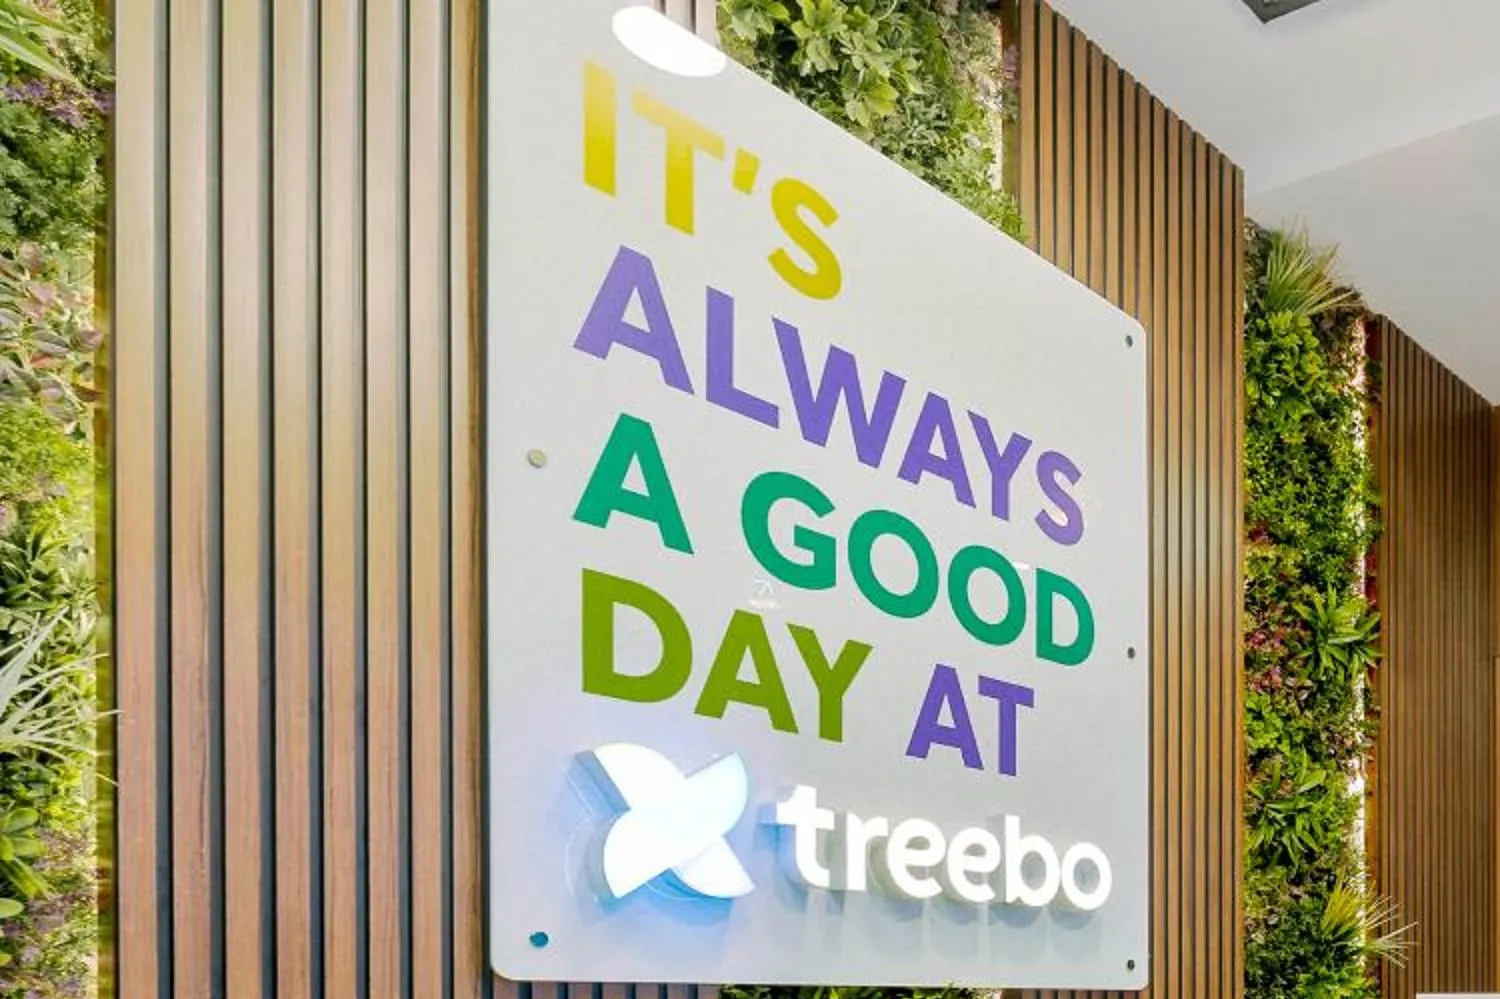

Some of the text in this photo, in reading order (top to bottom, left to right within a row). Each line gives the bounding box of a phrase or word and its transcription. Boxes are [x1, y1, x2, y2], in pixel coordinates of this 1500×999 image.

[581, 56, 842, 300] IT'S
[573, 245, 1085, 545] ALWAYS
[573, 413, 1095, 666] A GOOD
[581, 568, 1034, 777] DAY AT
[776, 785, 1112, 912] treebo
